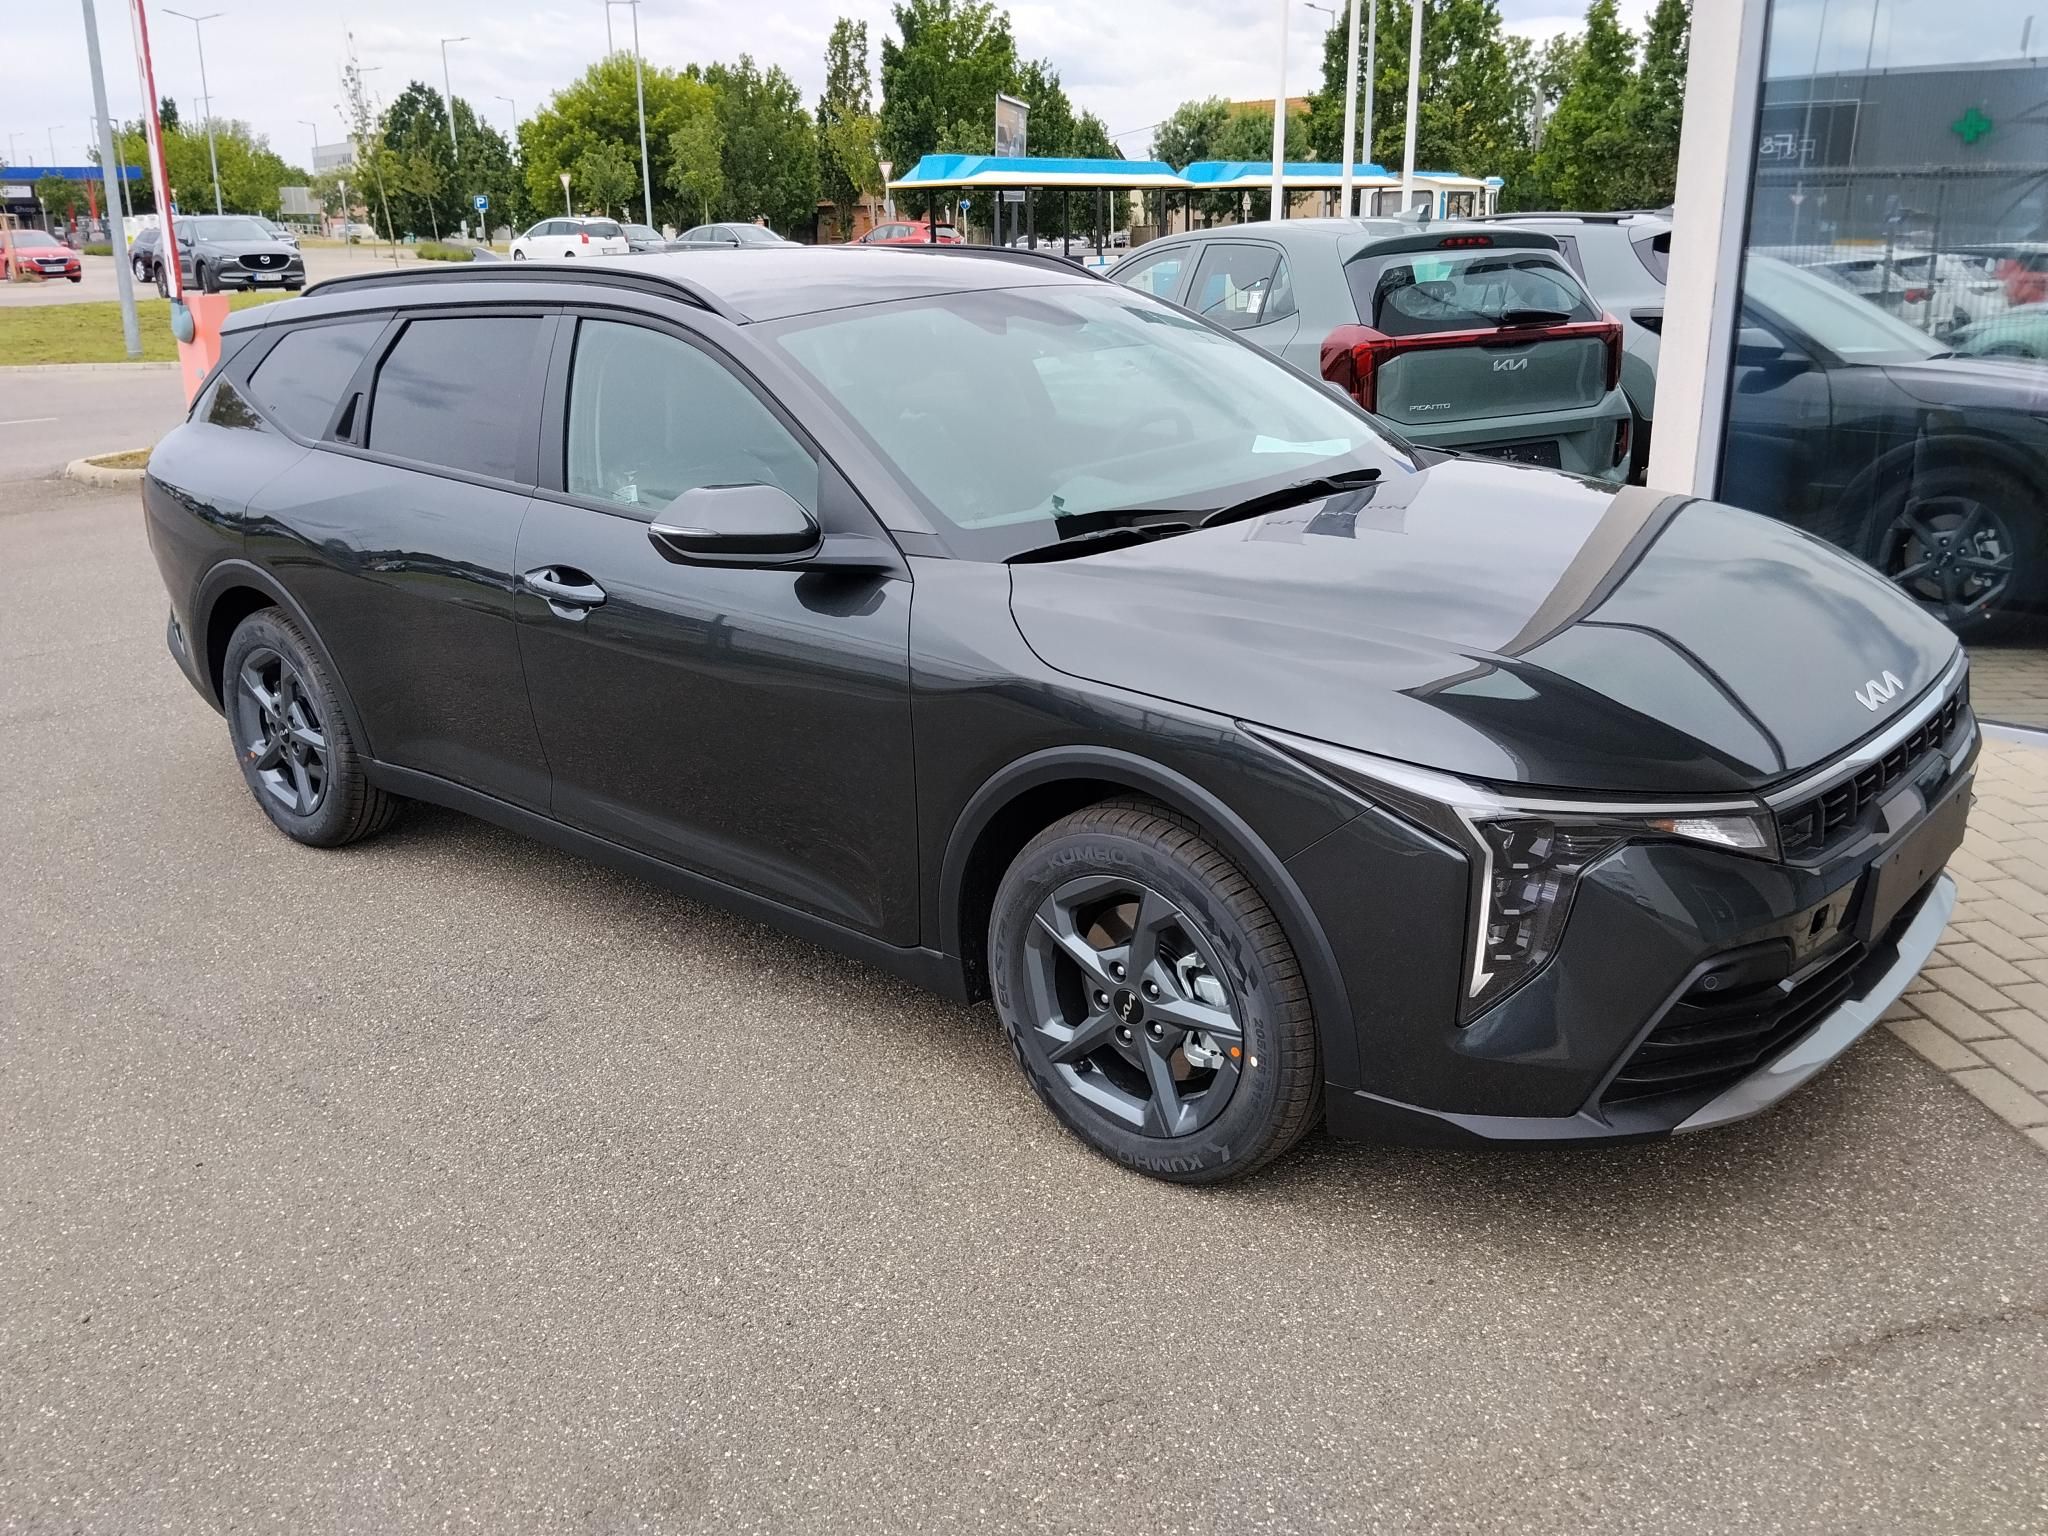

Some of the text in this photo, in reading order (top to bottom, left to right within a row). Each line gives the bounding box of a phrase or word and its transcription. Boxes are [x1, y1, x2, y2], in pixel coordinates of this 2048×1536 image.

[476, 197, 486, 208] P
[1493, 358, 1528, 371] KIA
[1409, 403, 1451, 411] PICANTO
[1854, 670, 1904, 712] KIA
[1048, 846, 1128, 869] KUMHO
